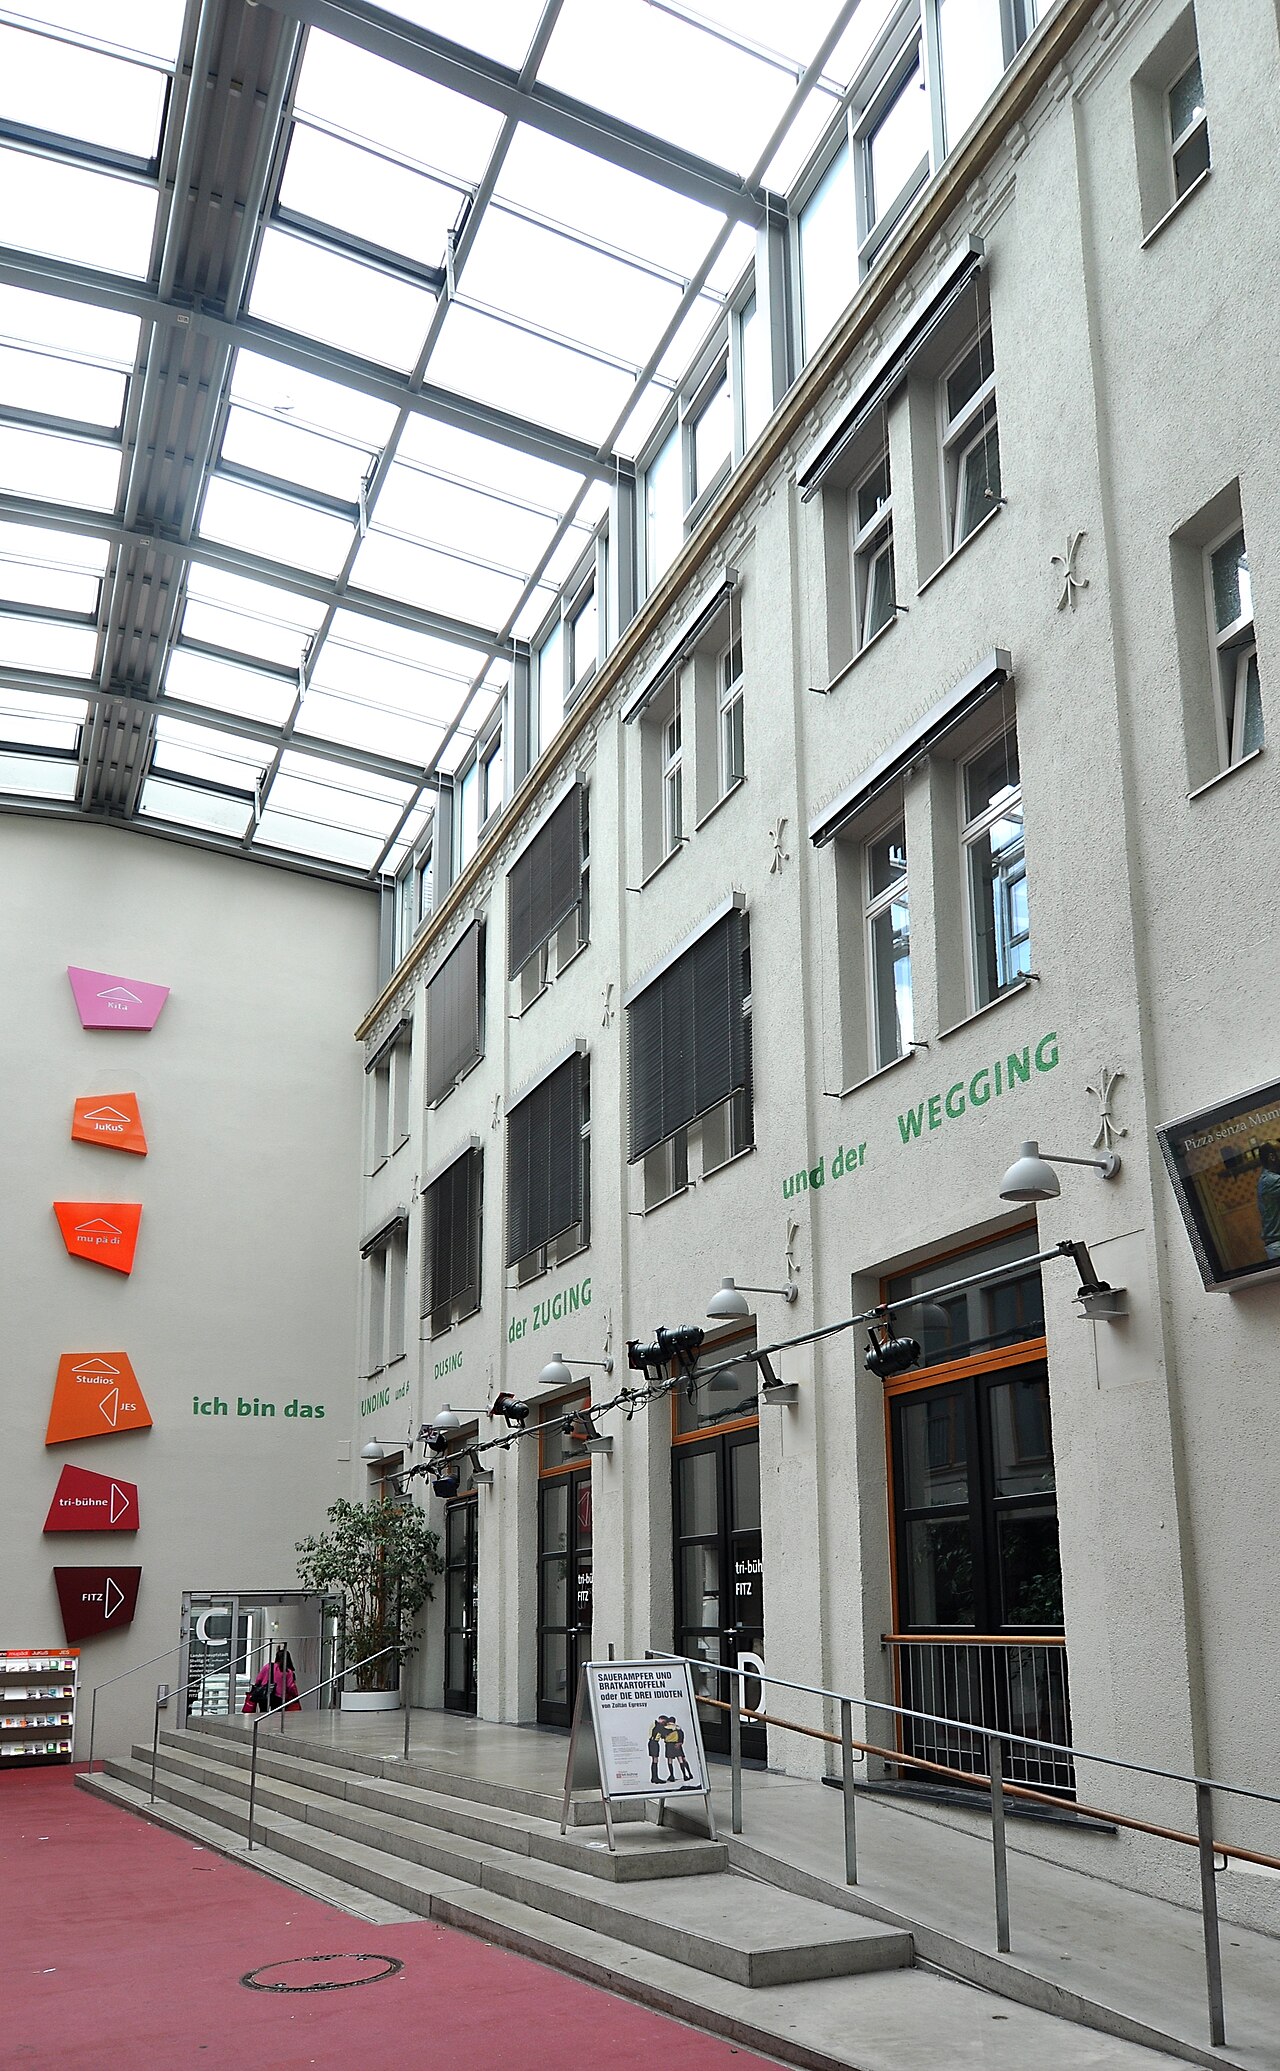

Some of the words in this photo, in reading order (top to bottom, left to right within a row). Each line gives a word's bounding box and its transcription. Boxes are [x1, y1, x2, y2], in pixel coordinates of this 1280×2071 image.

[107, 1001, 128, 1011] Kita
[782, 1157, 825, 1199] und
[831, 1142, 867, 1180] der
[897, 1031, 1060, 1145] WEGGING
[94, 1122, 124, 1132] JuKuS
[1184, 1134, 1215, 1151] Pizza
[1215, 1121, 1248, 1140] senza
[1247, 1107, 1280, 1128] Mam
[77, 1235, 94, 1243] mu
[95, 1235, 108, 1245] pä
[110, 1236, 120, 1244] di
[508, 1316, 528, 1344] der
[532, 1277, 593, 1331] ZUGING
[434, 1350, 463, 1380] DUSING
[76, 1375, 114, 1385] Studios
[119, 1403, 137, 1411] JES
[361, 1386, 390, 1417] UNDING
[192, 1396, 228, 1416] ich
[236, 1397, 276, 1417] bin
[283, 1399, 326, 1419] das
[59, 1497, 108, 1506] tri-bühne
[735, 1582, 753, 1596] FITZ
[82, 1593, 104, 1602] FITZ
[577, 1590, 590, 1602] FITZ
[196, 1607, 229, 1647] C
[597, 1672, 654, 1682] SAUERAMPFER
[655, 1671, 672, 1680] UND
[599, 1680, 666, 1690] BRATKARTOFFELN
[736, 1651, 767, 1724] D
[600, 1692, 618, 1701] oder
[620, 1691, 633, 1700] DIE
[634, 1691, 652, 1700] DREI
[653, 1690, 683, 1699] IDIOTEN
